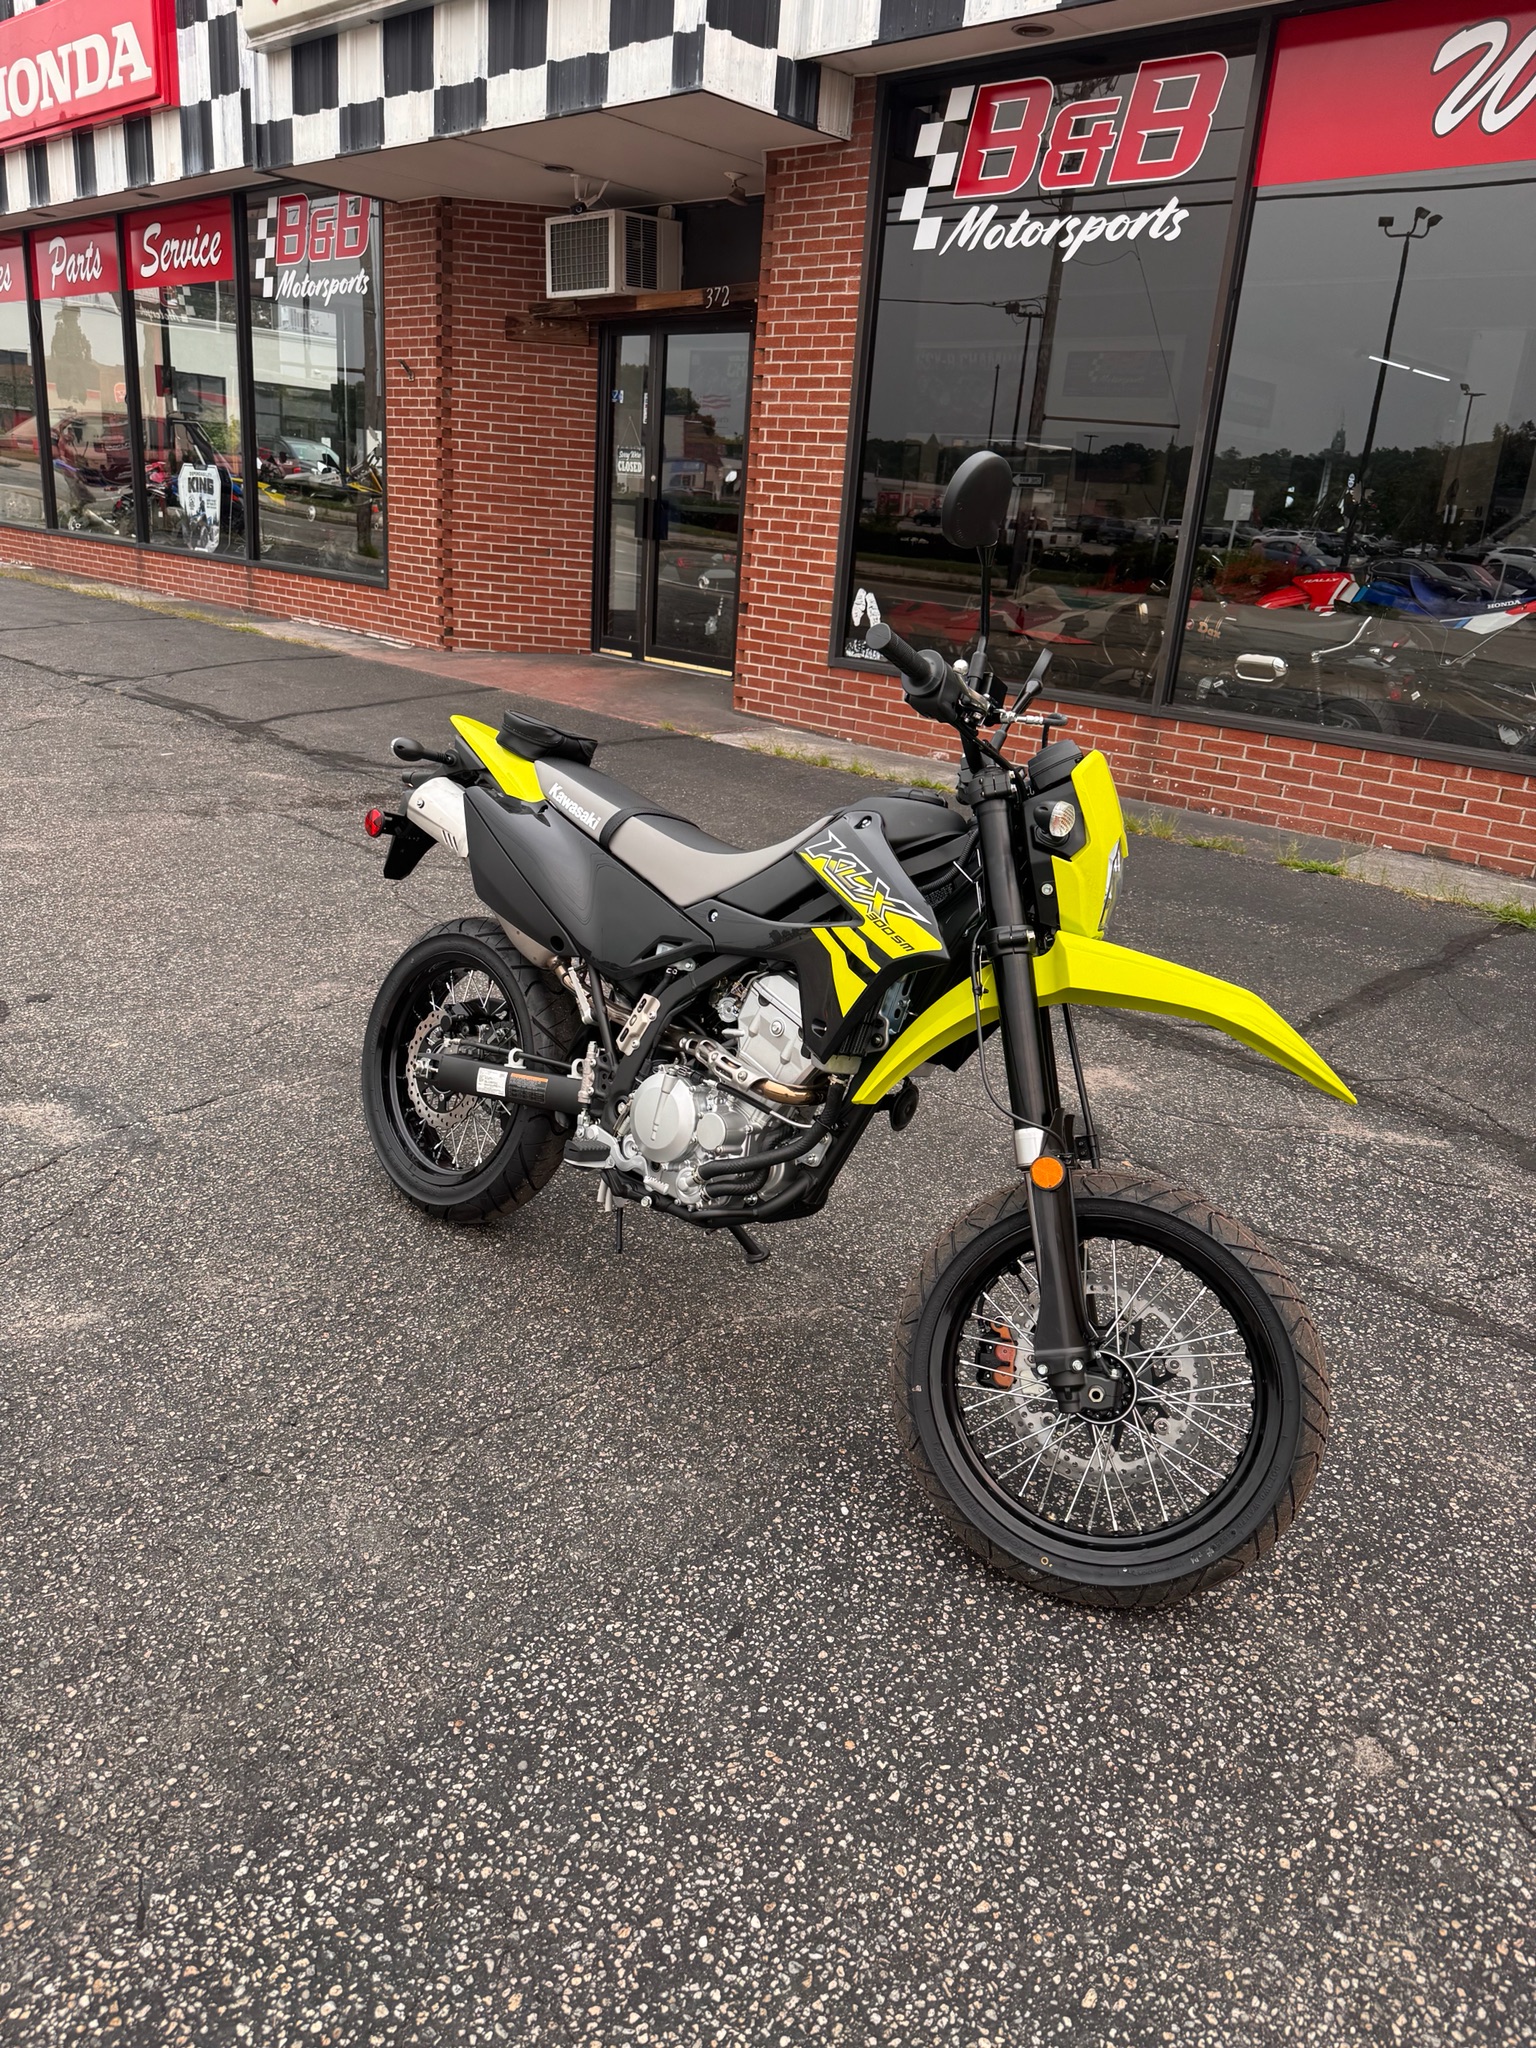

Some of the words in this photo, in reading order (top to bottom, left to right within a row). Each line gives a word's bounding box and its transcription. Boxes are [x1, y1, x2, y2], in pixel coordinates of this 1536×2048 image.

[953, 51, 1229, 199] B&B
[140, 222, 222, 279] Service
[275, 191, 372, 267] B&B
[938, 196, 1189, 263] Motorsports
[48, 236, 103, 291] Parts
[275, 267, 370, 307] Motorsports
[705, 285, 730, 309] 372
[188, 477, 214, 496] KING
[618, 461, 643, 473] CLOSED
[1487, 599, 1522, 610] HONDA
[1197, 621, 1221, 639] Dax
[548, 782, 602, 831] Kawasaki
[804, 829, 932, 926] KLX
